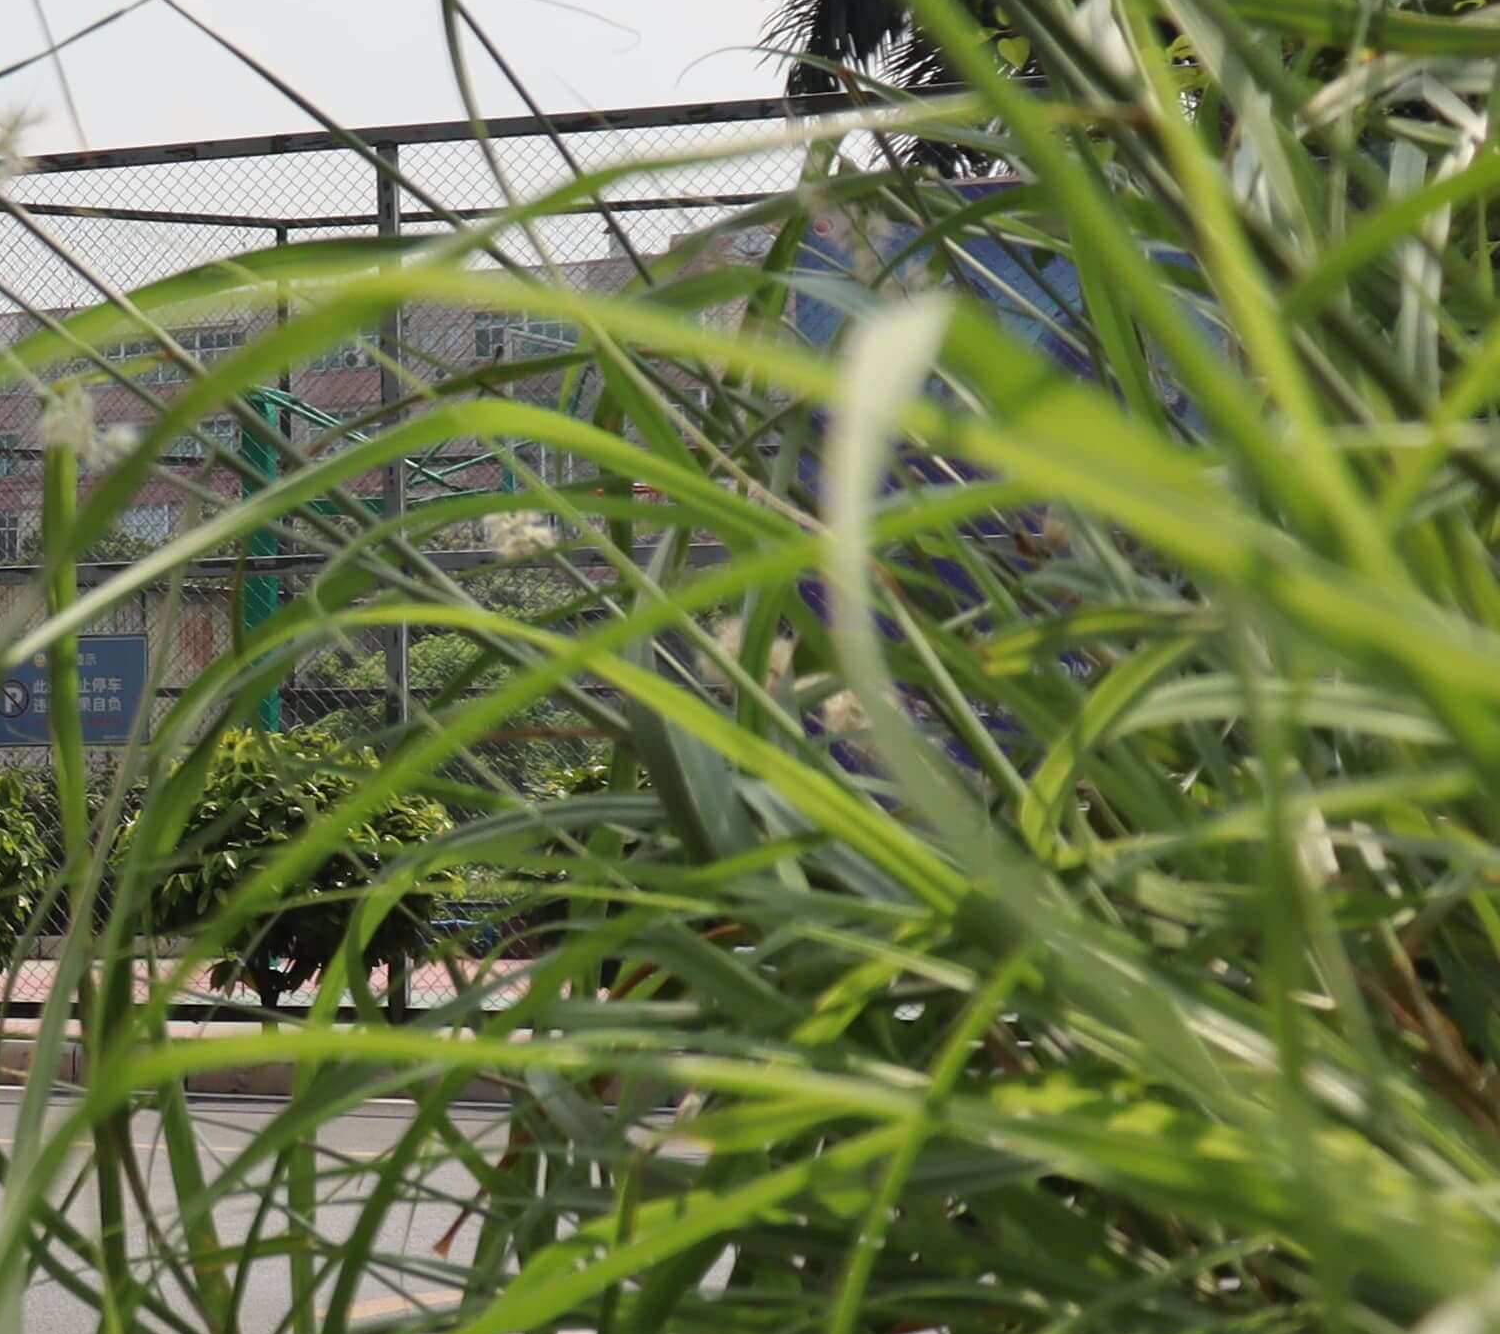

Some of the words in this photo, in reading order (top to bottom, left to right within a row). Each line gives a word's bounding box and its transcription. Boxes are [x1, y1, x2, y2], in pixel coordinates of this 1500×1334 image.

[32, 677, 123, 694] 此止停车
[32, 697, 123, 714] 违果自负
